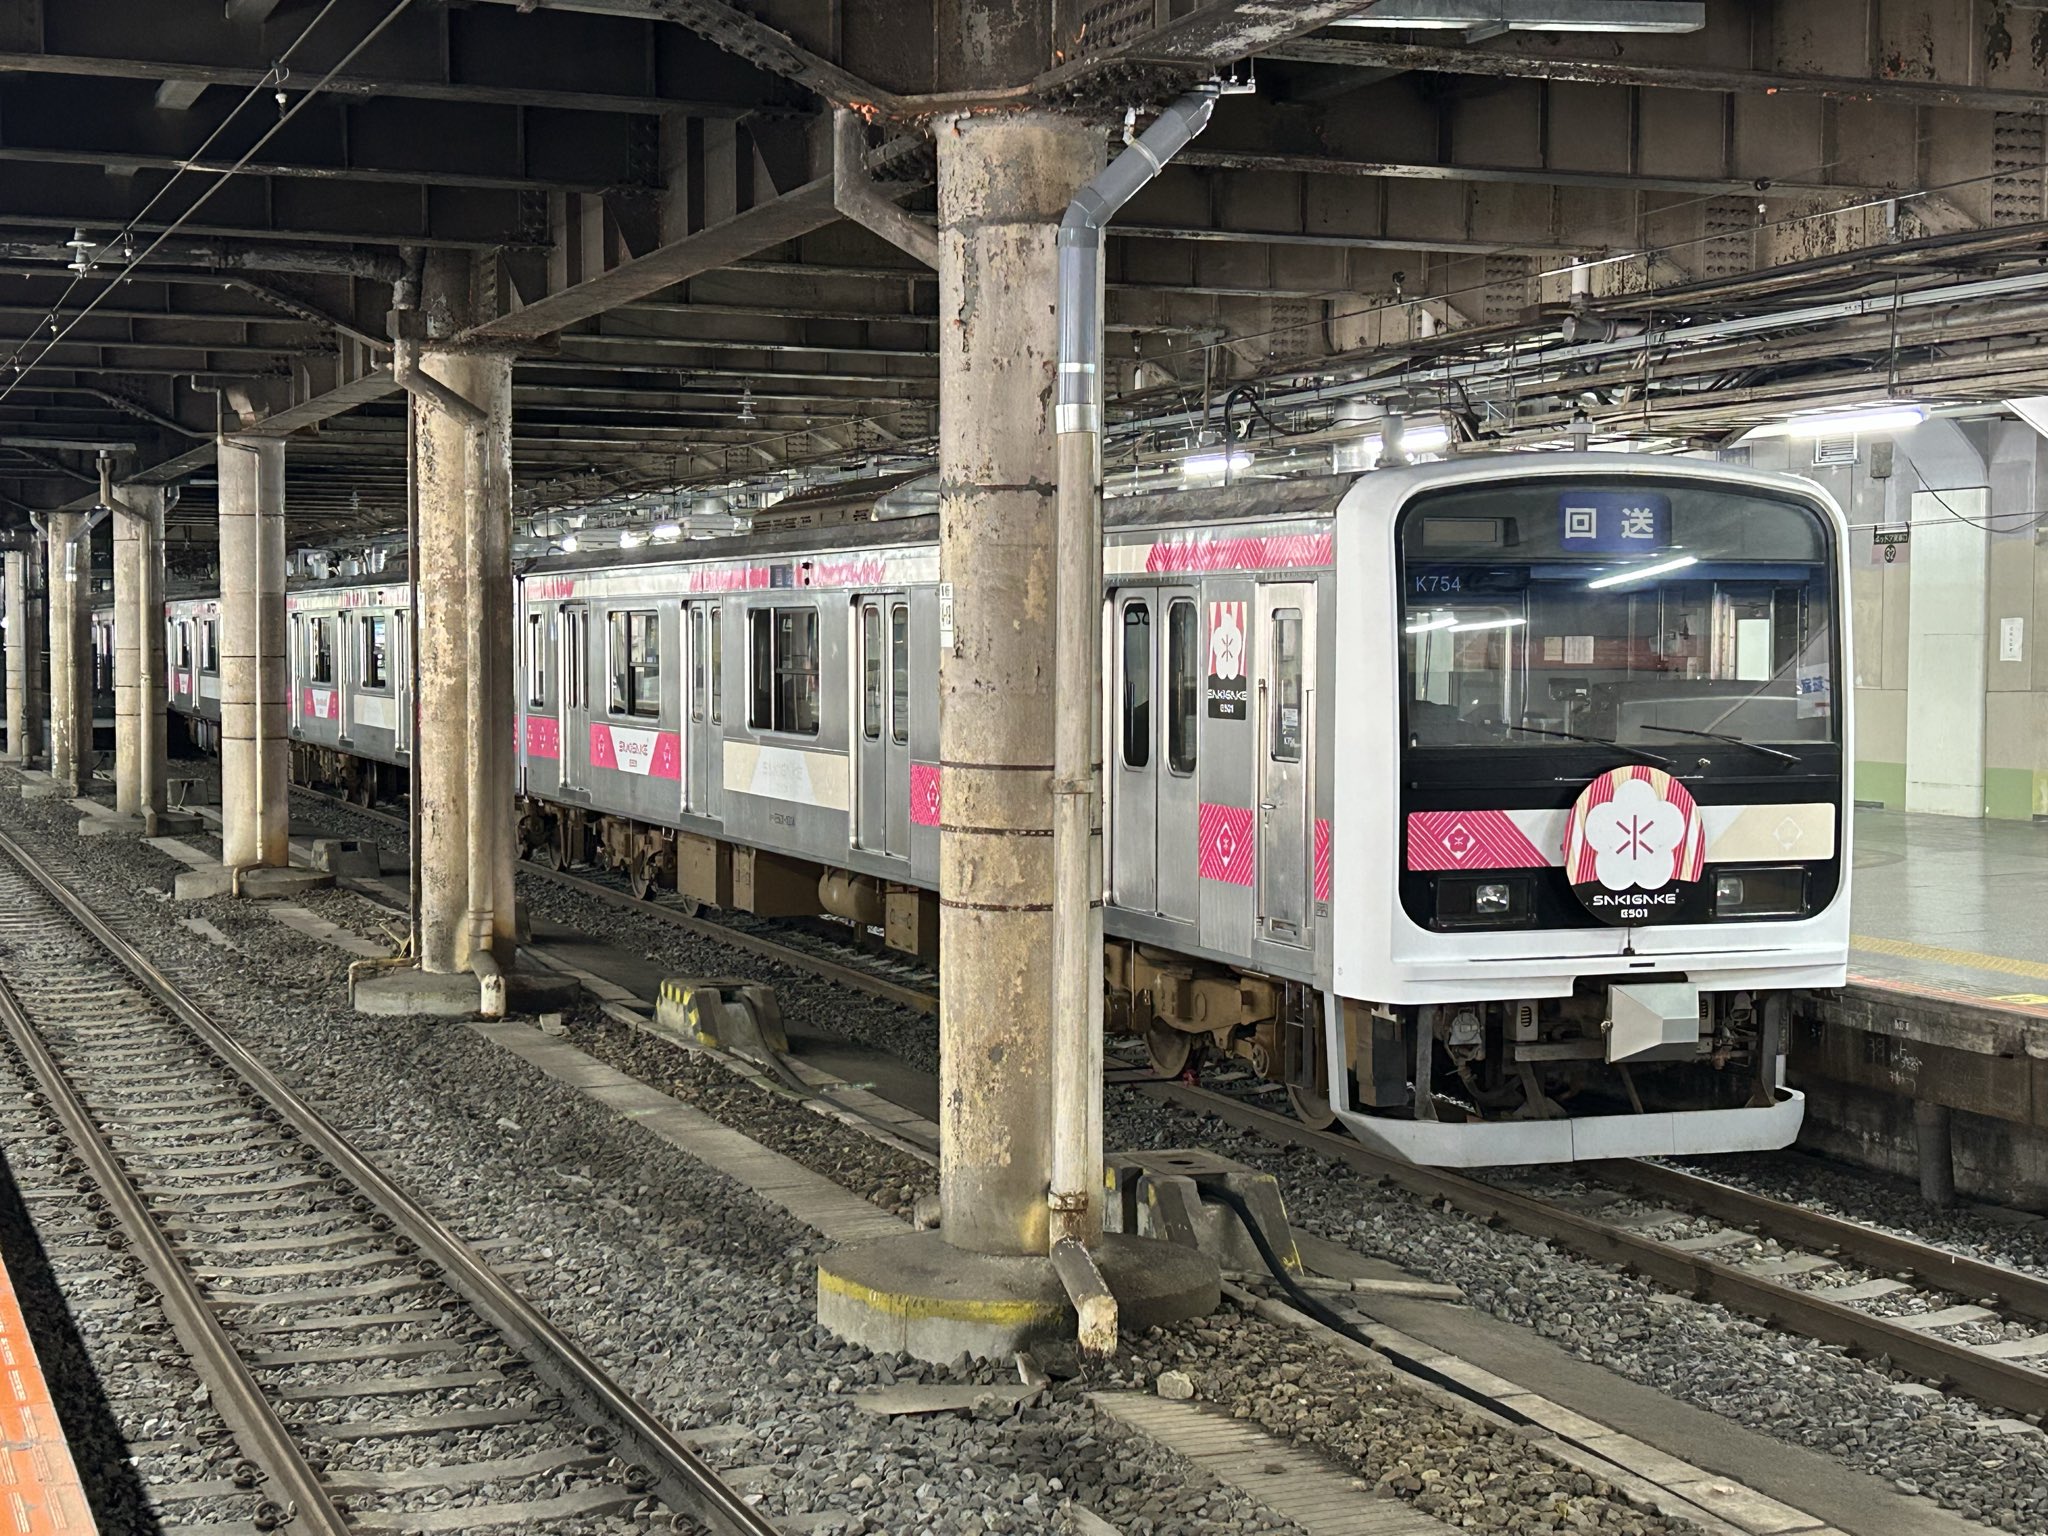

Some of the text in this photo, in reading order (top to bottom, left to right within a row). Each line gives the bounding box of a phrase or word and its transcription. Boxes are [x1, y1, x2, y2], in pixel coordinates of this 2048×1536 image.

[1565, 507, 1654, 539] 回送
[1415, 575, 1461, 592] K754
[1592, 893, 1677, 905] SAKIGAKE
